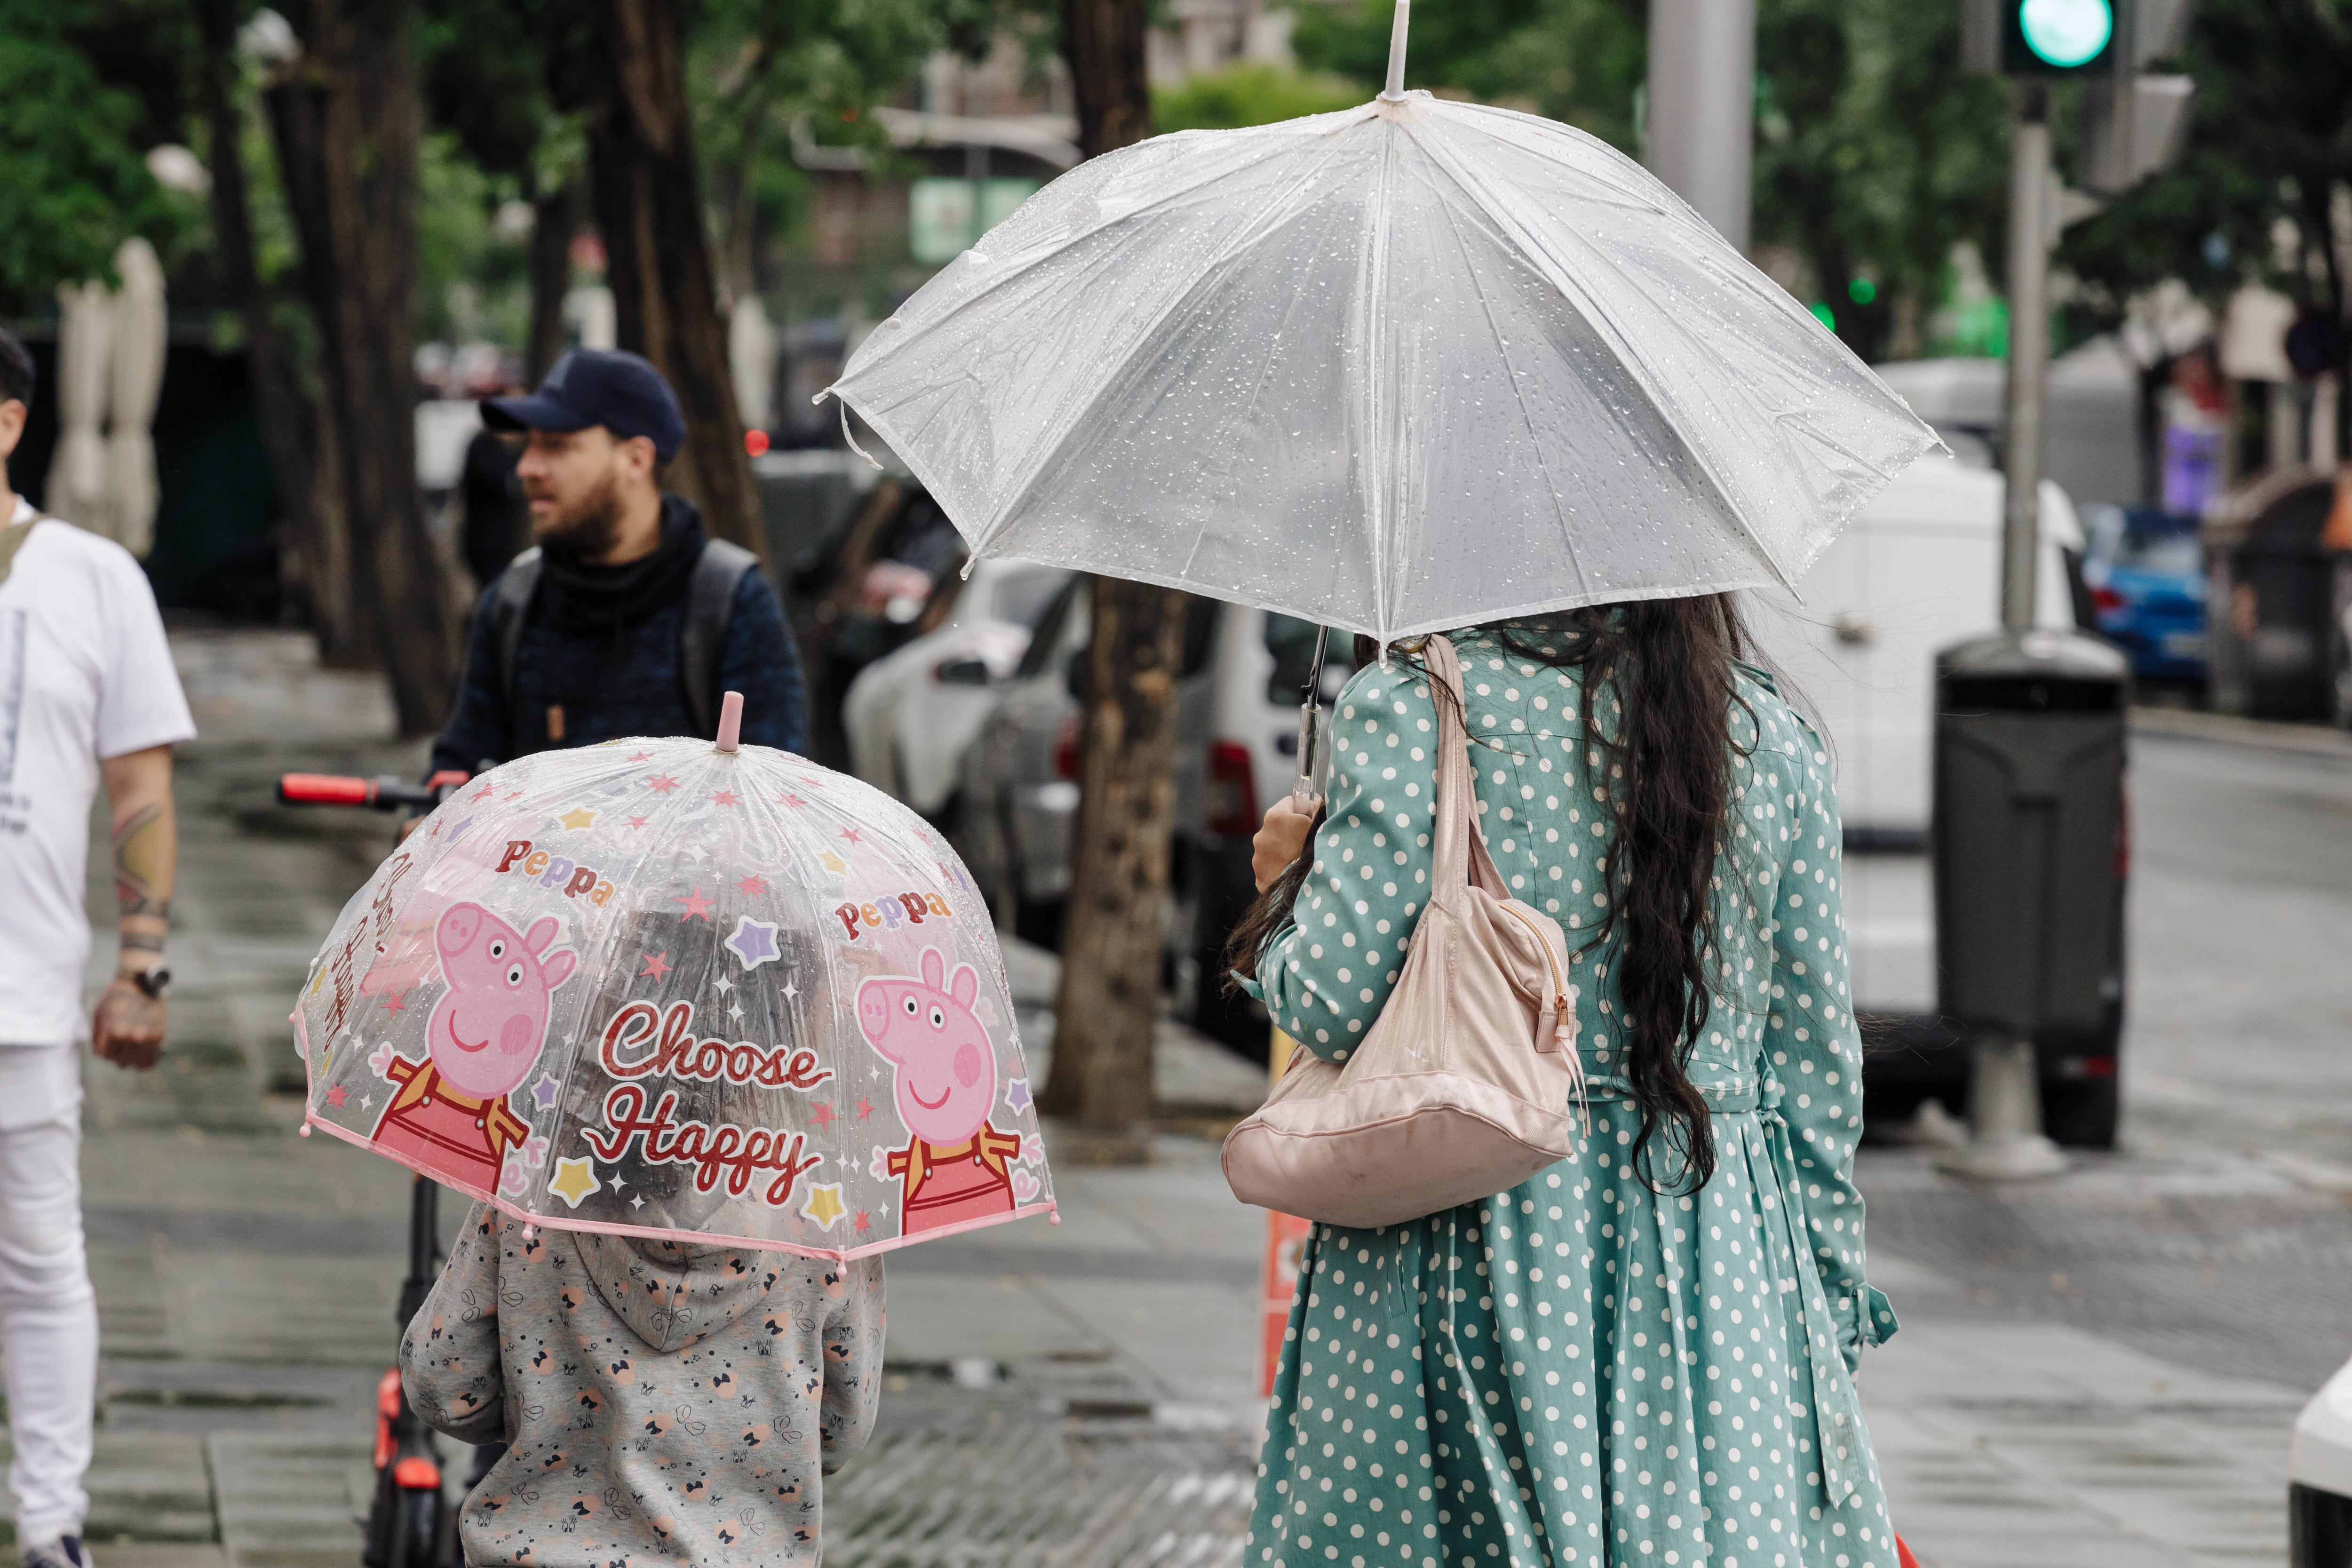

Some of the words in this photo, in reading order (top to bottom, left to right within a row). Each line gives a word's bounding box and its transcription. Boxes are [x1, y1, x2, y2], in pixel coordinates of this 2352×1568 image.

[495, 840, 613, 908] Peppa
[835, 892, 952, 940] Peppa
[602, 1003, 832, 1089] Choose
[583, 1086, 821, 1205] Happy
